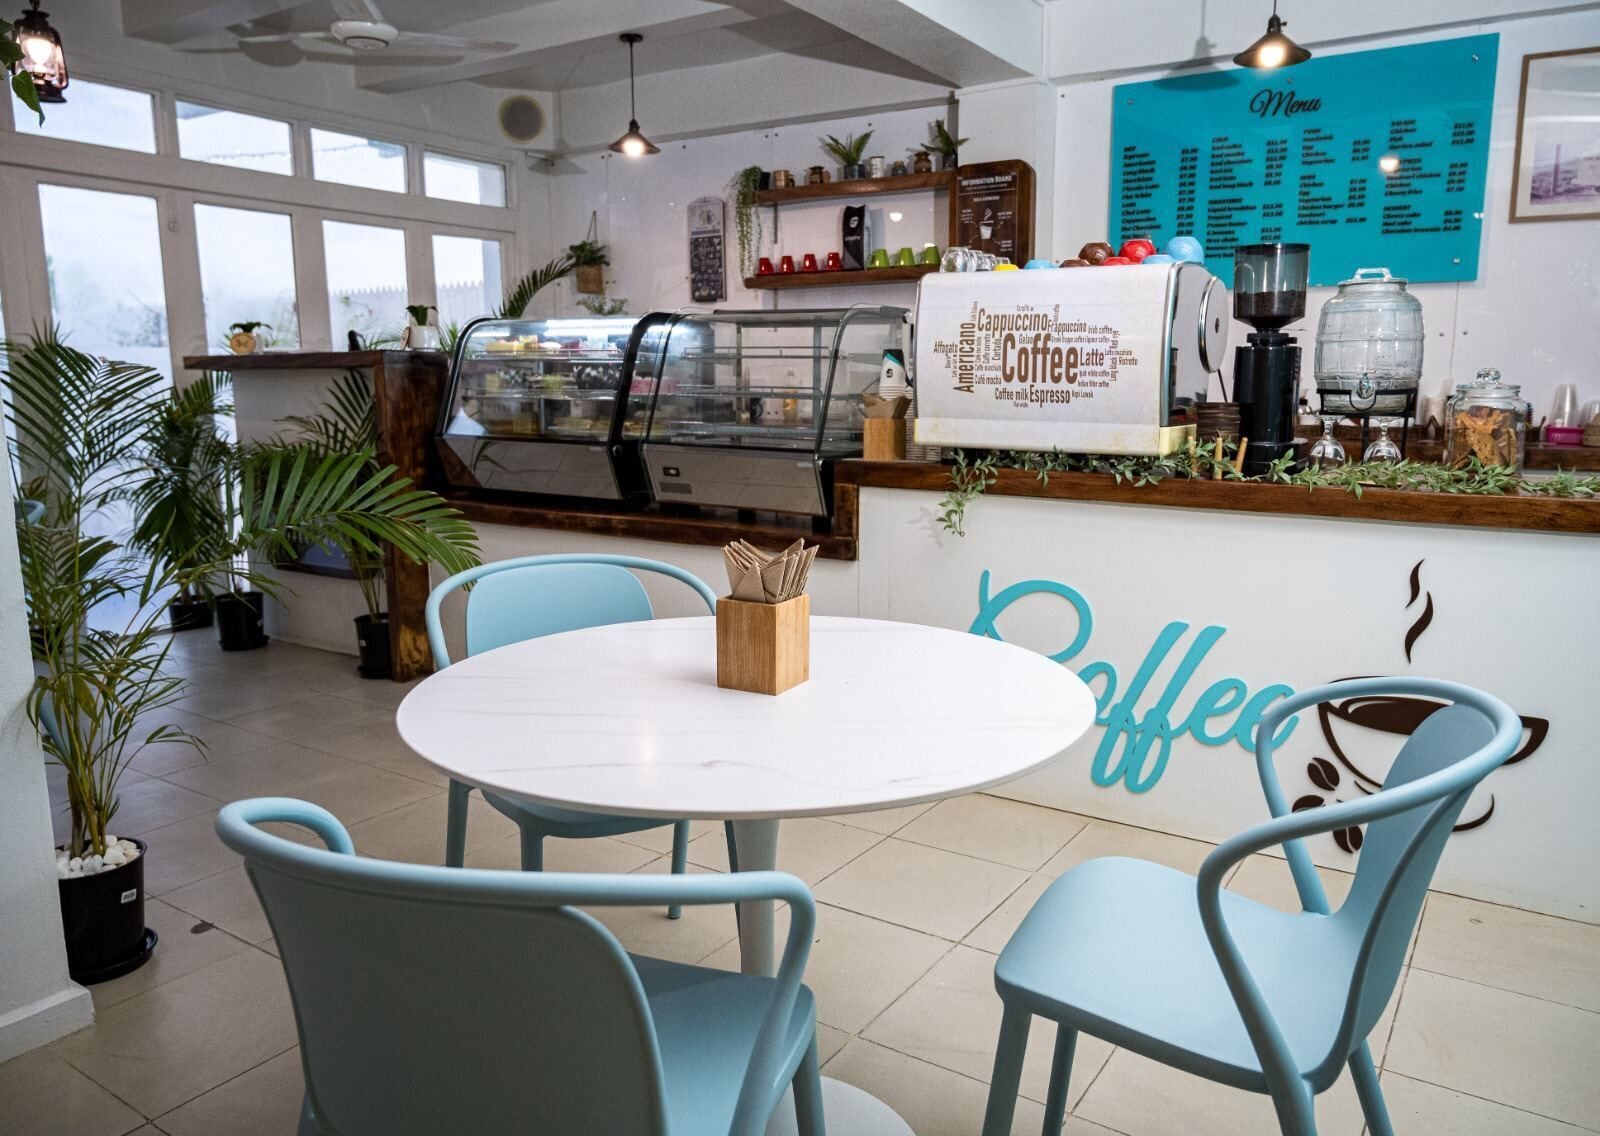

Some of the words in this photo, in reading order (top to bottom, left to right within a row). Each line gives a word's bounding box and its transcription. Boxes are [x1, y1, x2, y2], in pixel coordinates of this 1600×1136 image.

[1250, 89, 1322, 118] Menu
[978, 308, 1048, 338] Cappuccino
[1048, 318, 1086, 336] Frappuccino
[1088, 326, 1098, 334] Irish
[1098, 324, 1112, 334] coffee
[934, 340, 958, 355] Affogato
[992, 338, 1001, 360] Cortado
[1109, 340, 1118, 349] Red
[953, 323, 976, 393] Americano
[1002, 332, 1078, 384] Coffee
[1080, 346, 1104, 366] Latte
[1119, 357, 1137, 366] Ristretto
[975, 374, 985, 384] Café
[986, 376, 1001, 384] mocha
[1109, 370, 1118, 381] Long
[995, 388, 1013, 400] Coffee
[1016, 388, 1029, 400] milk
[1030, 384, 1070, 408] Espresso
